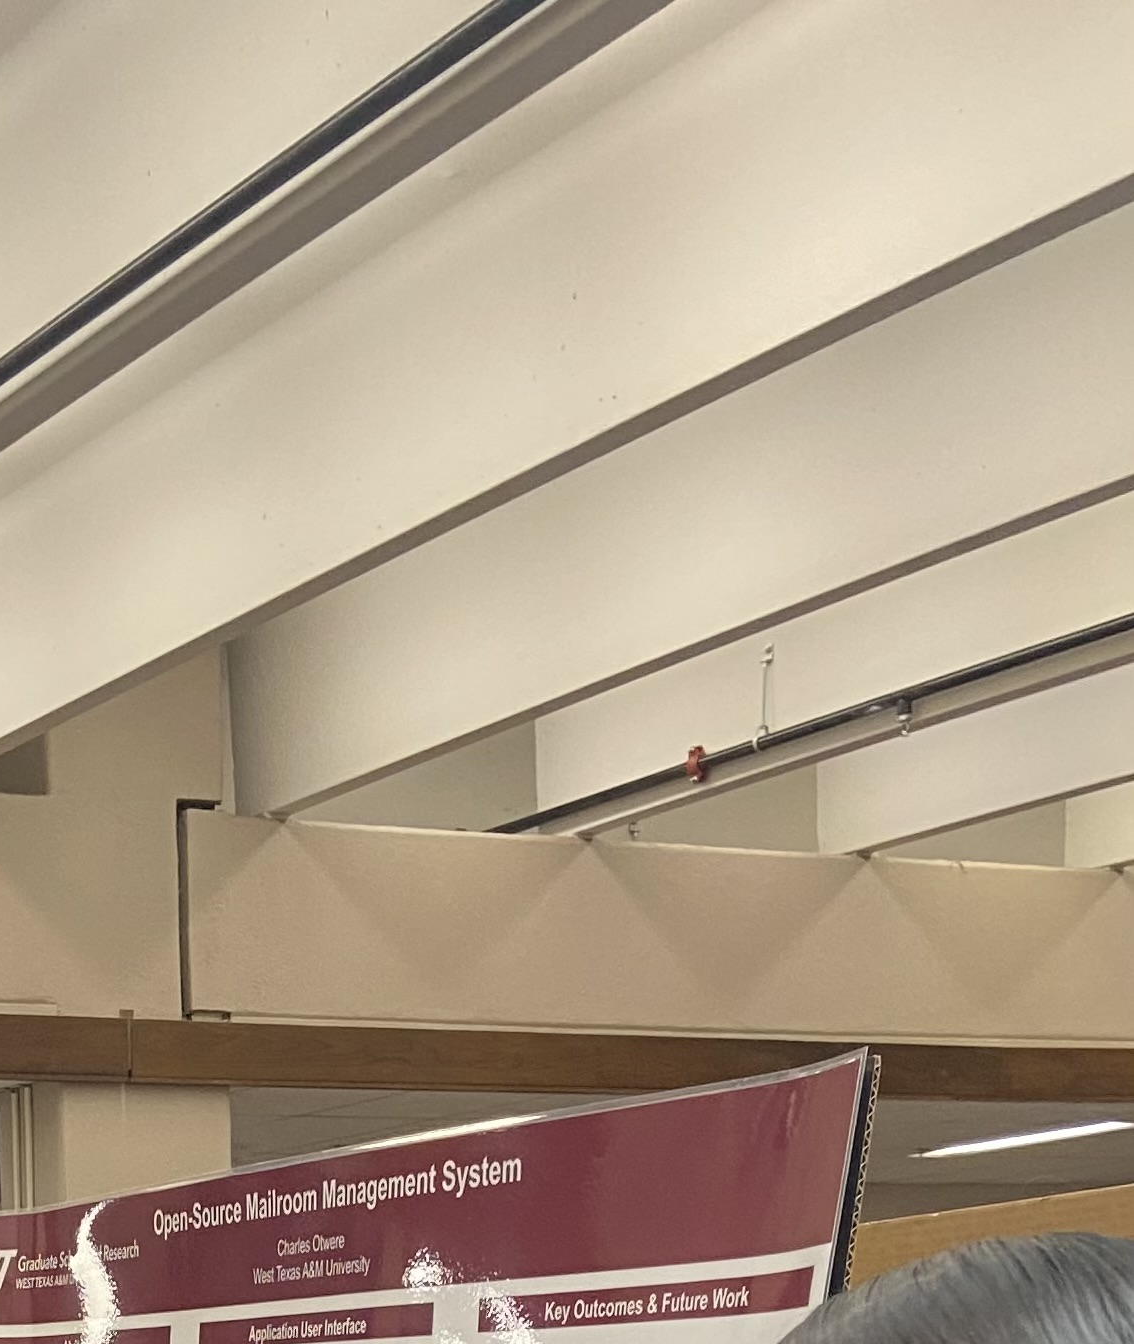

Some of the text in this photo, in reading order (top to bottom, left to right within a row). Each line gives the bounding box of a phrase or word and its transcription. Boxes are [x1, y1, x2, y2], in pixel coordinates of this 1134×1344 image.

[154, 1157, 522, 1239] Open-Source Mailroom Management System
[18, 1253, 58, 1272] Graduate
[103, 1239, 140, 1261] Research
[277, 1234, 345, 1257] Charles Otwere
[16, 1276, 36, 1289] WEST
[36, 1275, 54, 1288] TEXAS
[253, 1255, 371, 1284] West Texas A&M University
[544, 1286, 750, 1325] Key Outcomes & Future Work
[248, 1317, 367, 1344] Application User Interface
